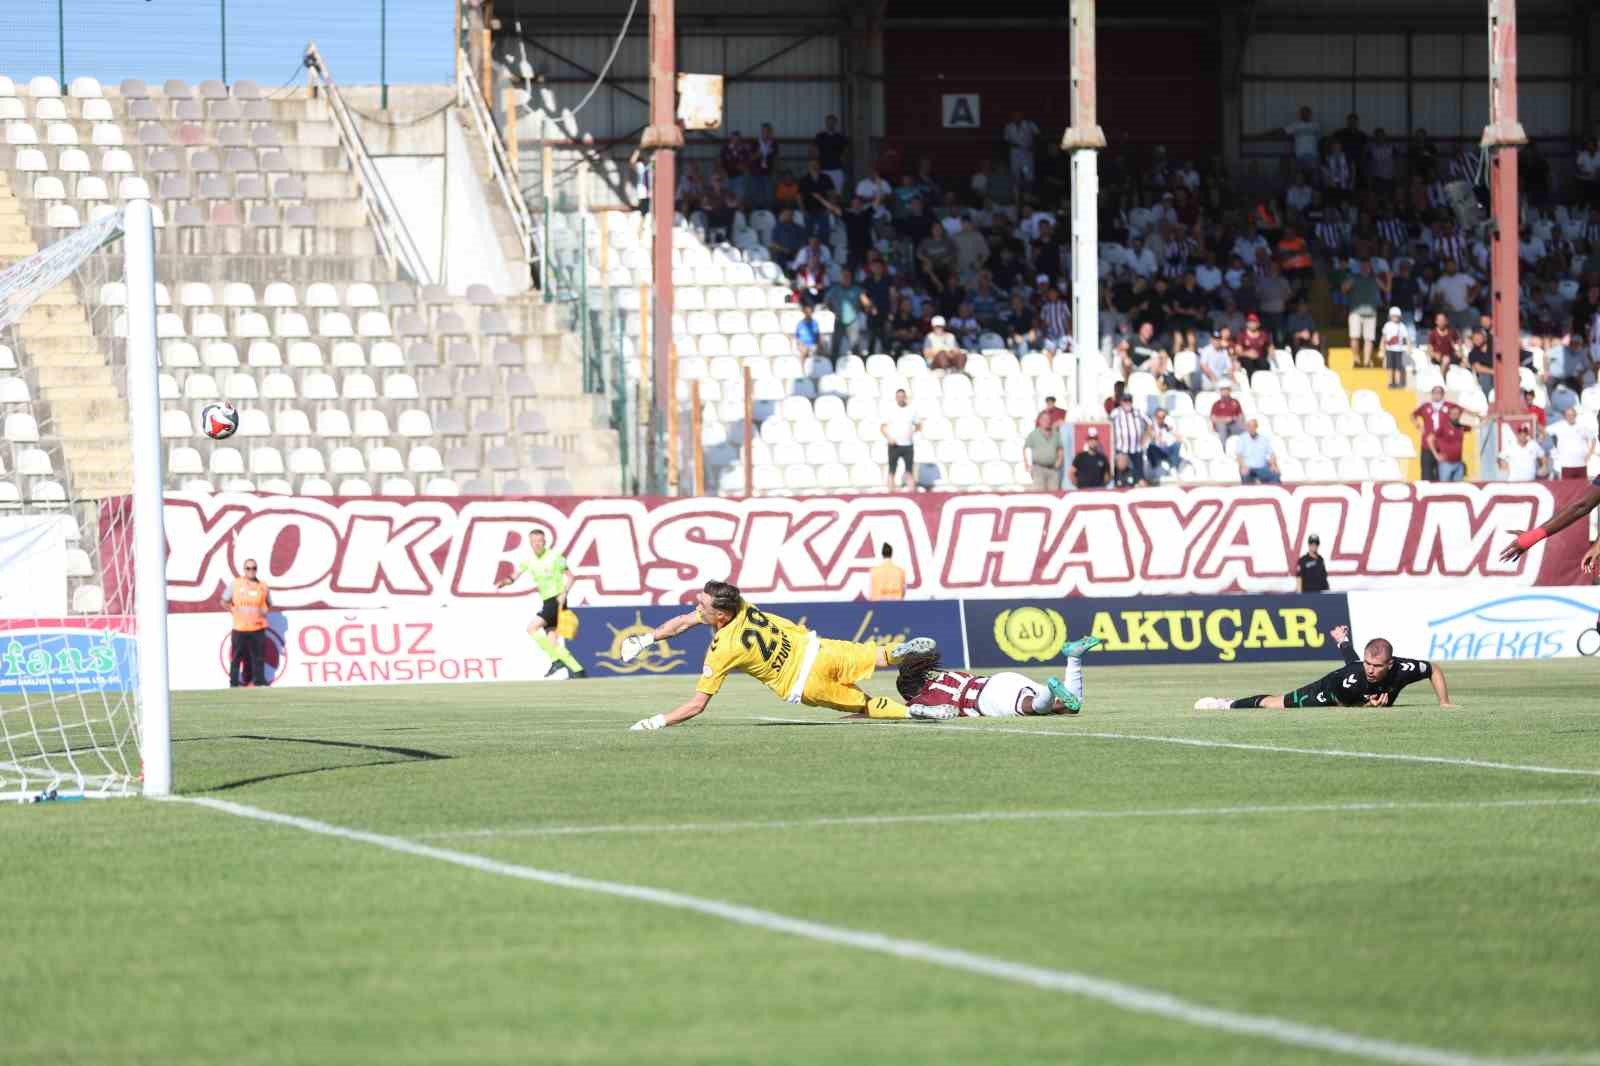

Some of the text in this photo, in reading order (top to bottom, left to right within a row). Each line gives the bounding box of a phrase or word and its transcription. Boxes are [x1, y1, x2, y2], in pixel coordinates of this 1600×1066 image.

[949, 96, 976, 125] A
[162, 483, 1540, 604] YOK BAŞKA HAYALİM
[298, 615, 436, 657] OĞUZ
[770, 631, 792, 673] SZUM
[1080, 607, 1325, 662] AKUÇAR
[1427, 629, 1567, 661] KAFKAS
[0, 640, 116, 676] fans
[300, 657, 503, 682] TRANSPORT
